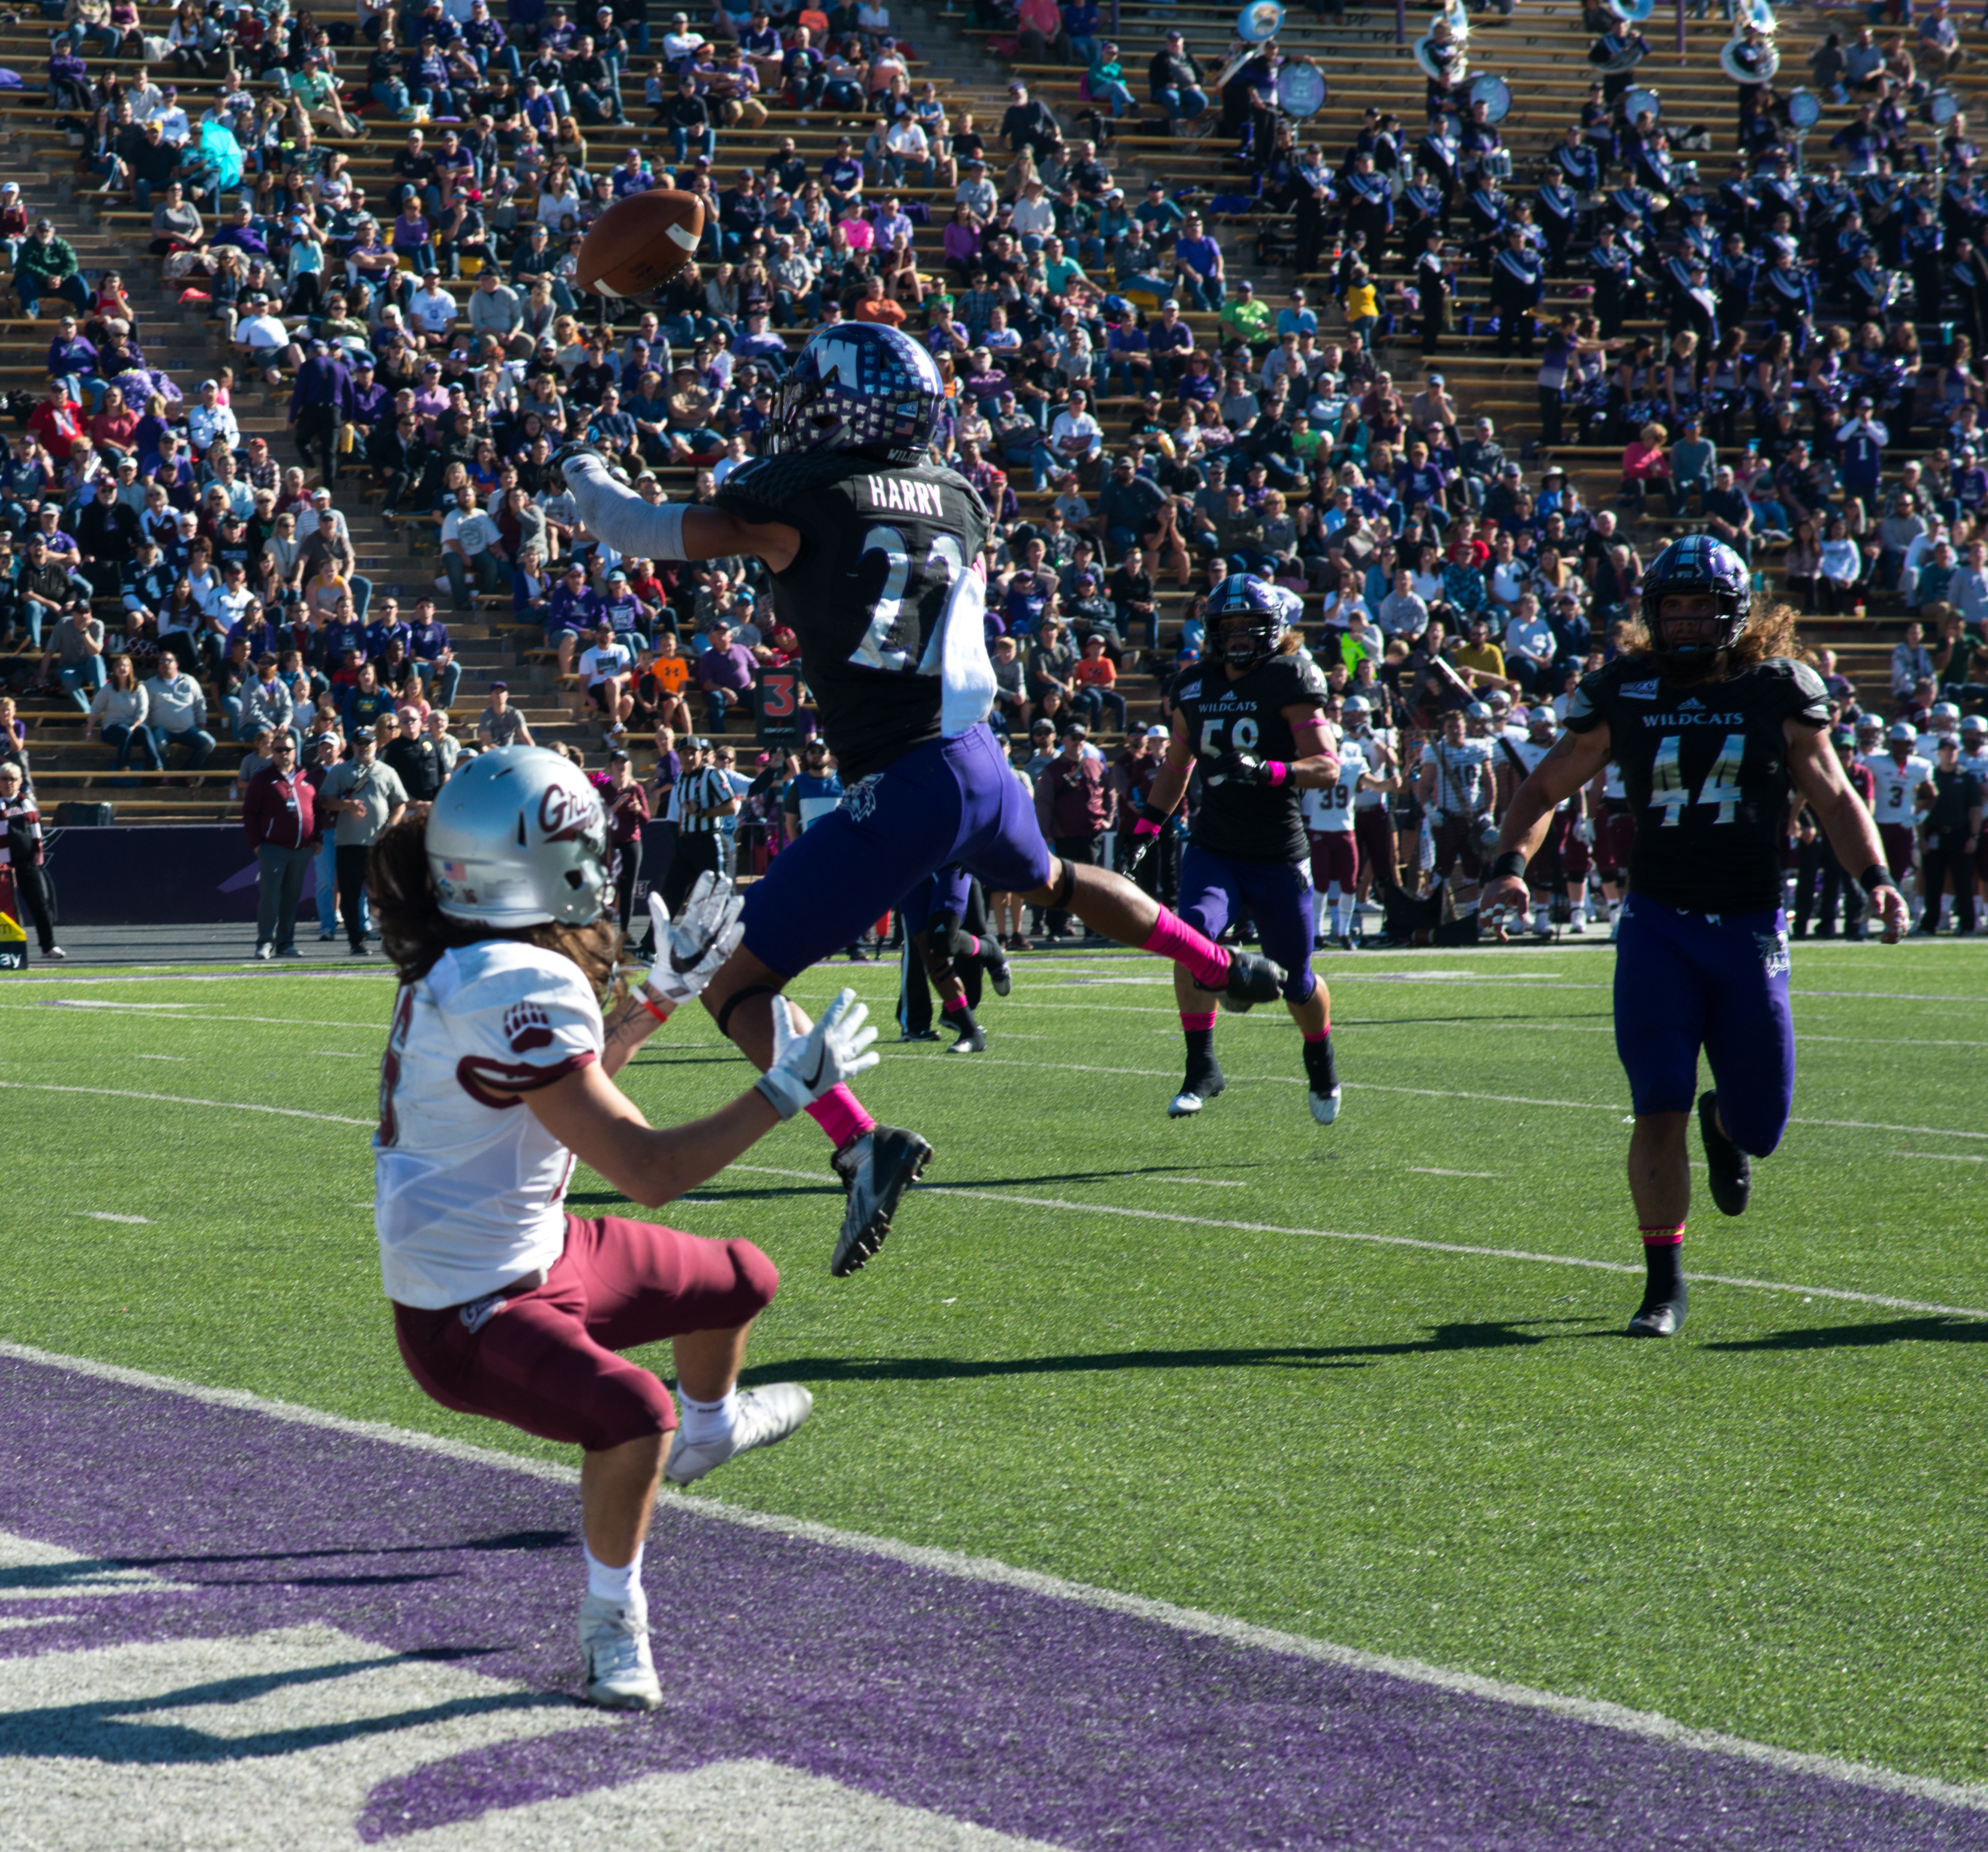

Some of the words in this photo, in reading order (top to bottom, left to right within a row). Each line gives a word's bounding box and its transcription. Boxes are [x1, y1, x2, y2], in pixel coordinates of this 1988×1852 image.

[868, 474, 943, 516] HARRY
[847, 524, 965, 676] 22
[763, 675, 795, 716] 3
[1199, 701, 1257, 713] WILDCATS
[1642, 712, 1745, 727] WILDCATS
[1318, 784, 1348, 810] 39
[1647, 734, 1746, 827] 44
[1889, 786, 1904, 808] 3
